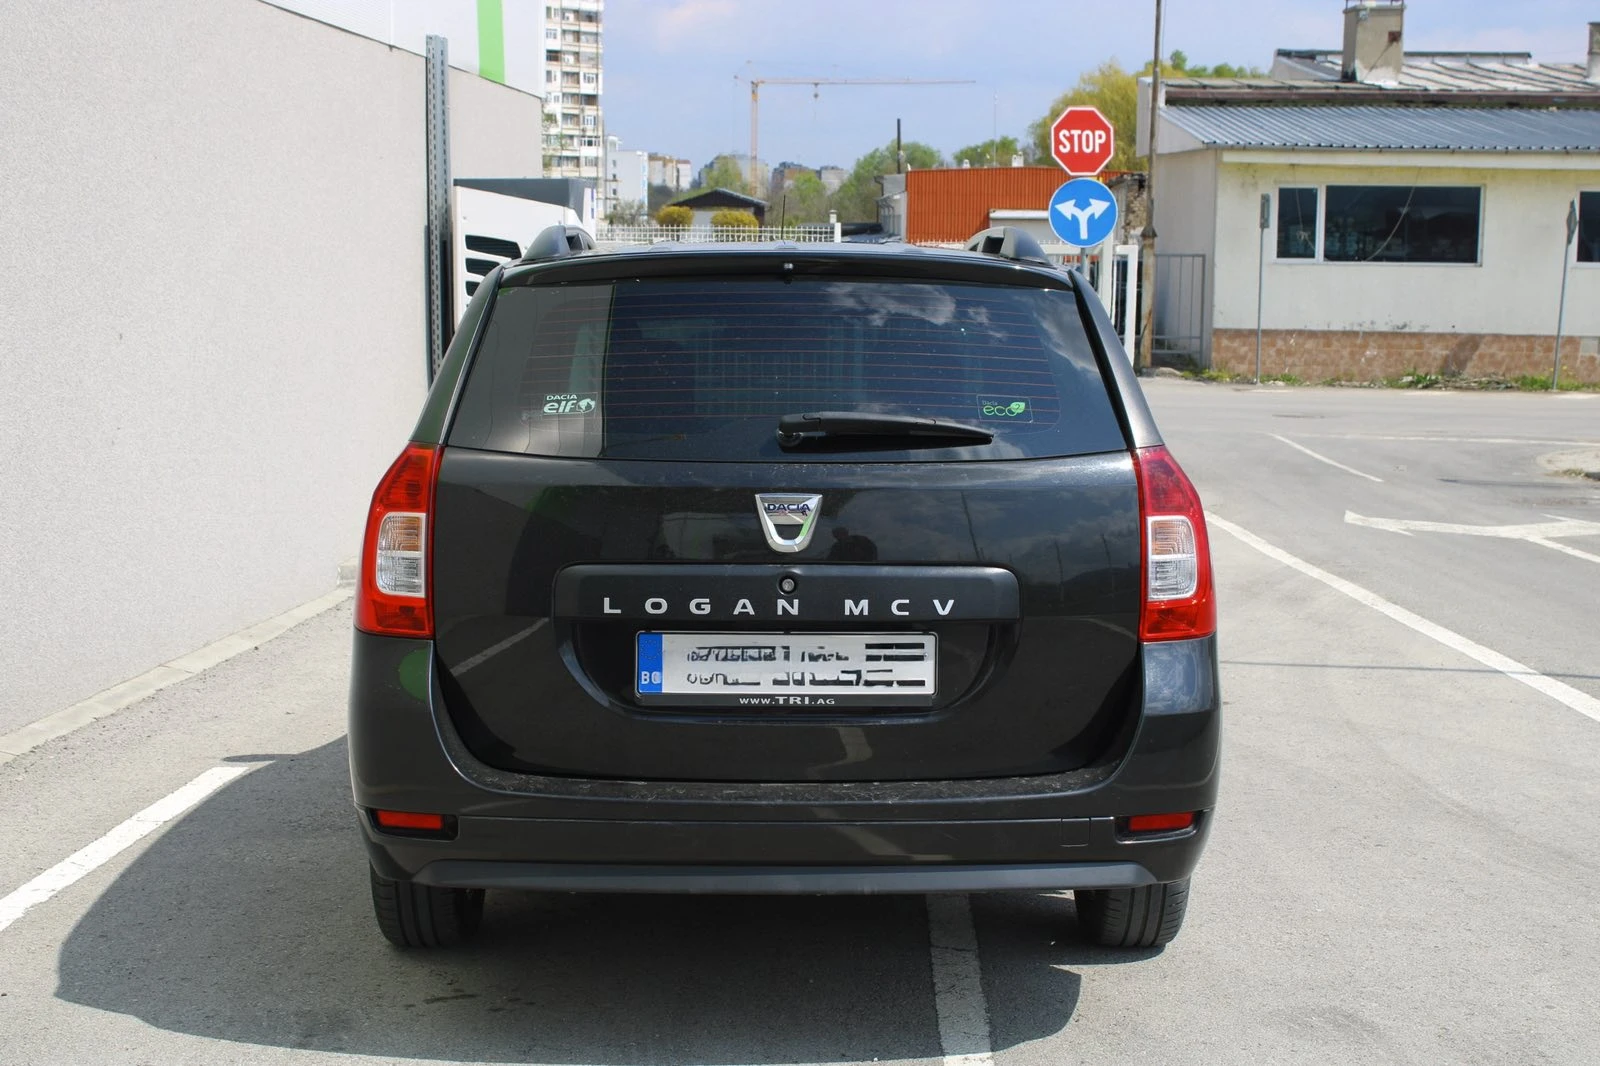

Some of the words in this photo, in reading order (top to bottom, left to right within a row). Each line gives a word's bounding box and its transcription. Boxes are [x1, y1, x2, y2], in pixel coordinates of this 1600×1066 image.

[1058, 129, 1107, 153] STOP
[543, 400, 577, 413] elf
[767, 503, 811, 512] DACIA
[603, 597, 799, 616] LOGAN
[844, 599, 954, 616] MCV
